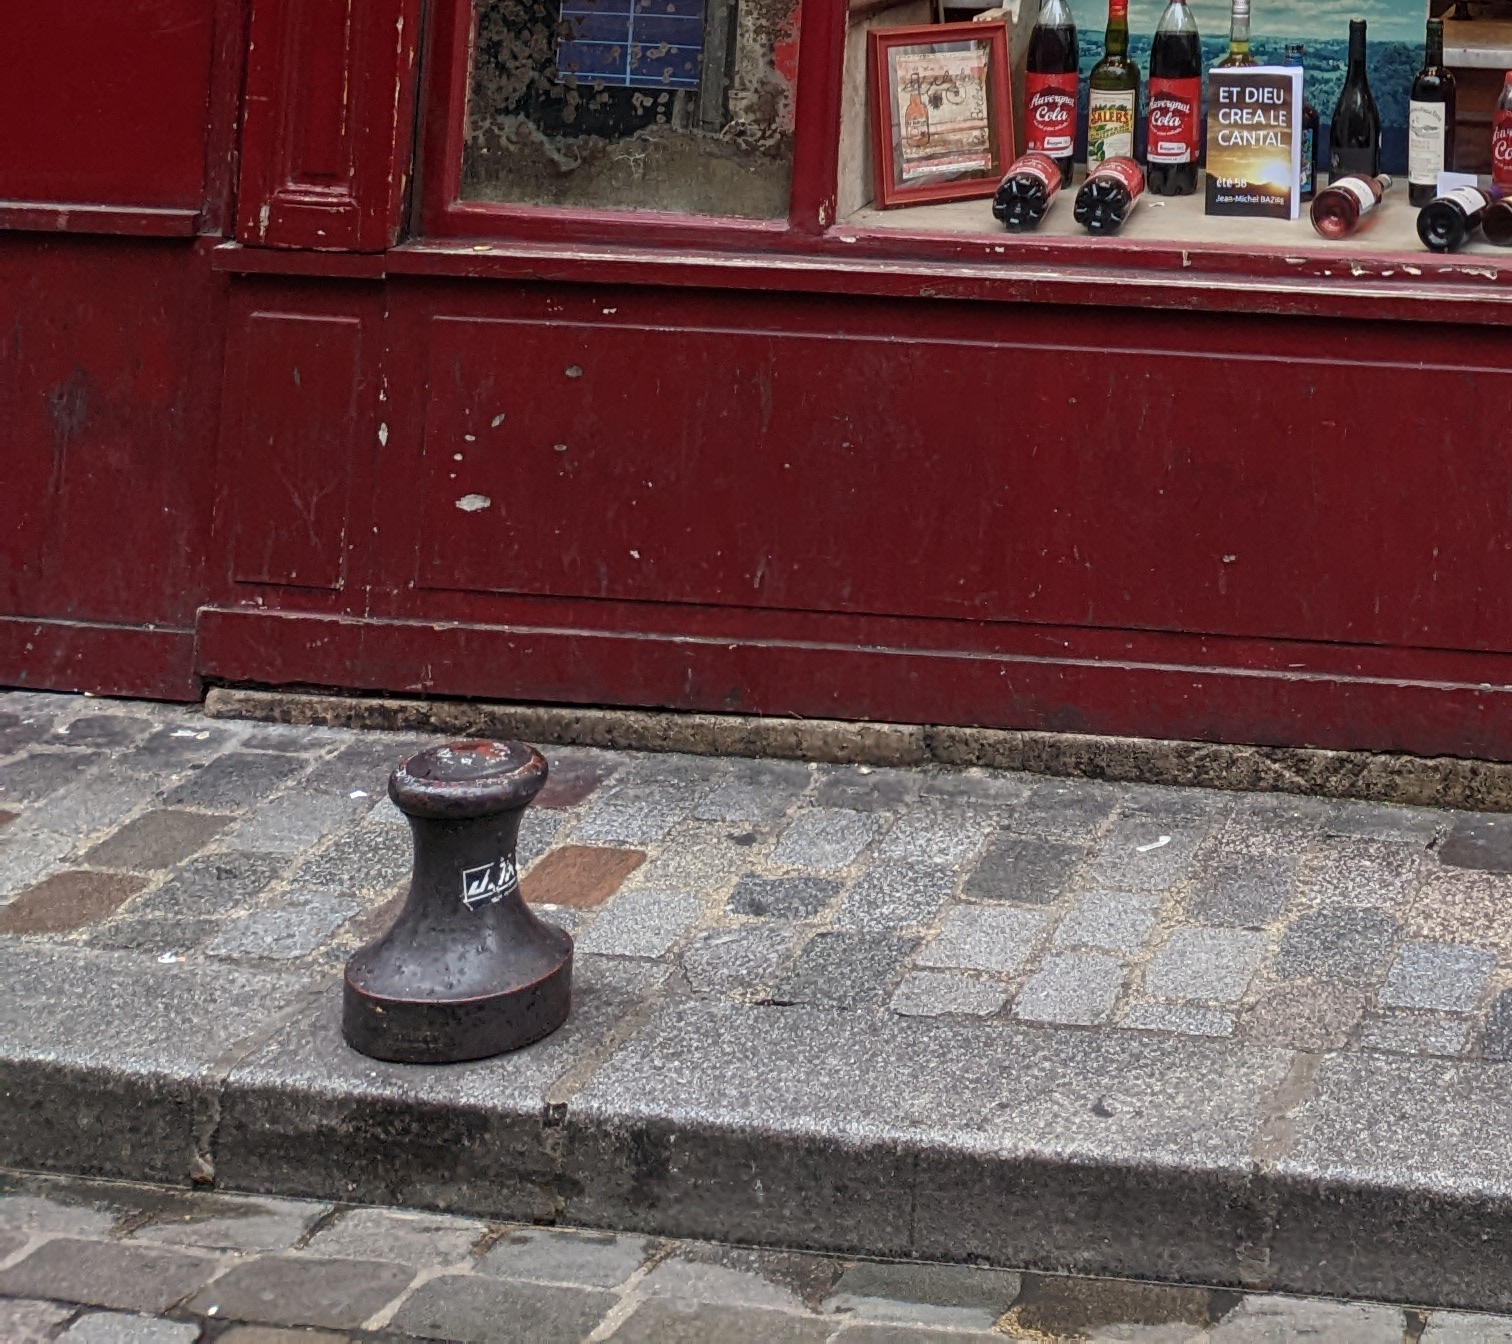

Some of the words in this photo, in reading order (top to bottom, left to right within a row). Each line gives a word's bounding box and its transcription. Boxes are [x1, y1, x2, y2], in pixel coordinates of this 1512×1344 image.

[1219, 87, 1241, 103] ET
[1245, 87, 1284, 104] DIEU
[1035, 105, 1068, 122] Cola
[1090, 109, 1129, 125] SALERS
[1151, 110, 1182, 127] Cola
[1218, 108, 1266, 125] CREA
[1270, 111, 1287, 126] LE
[1218, 130, 1286, 148] CANTAL
